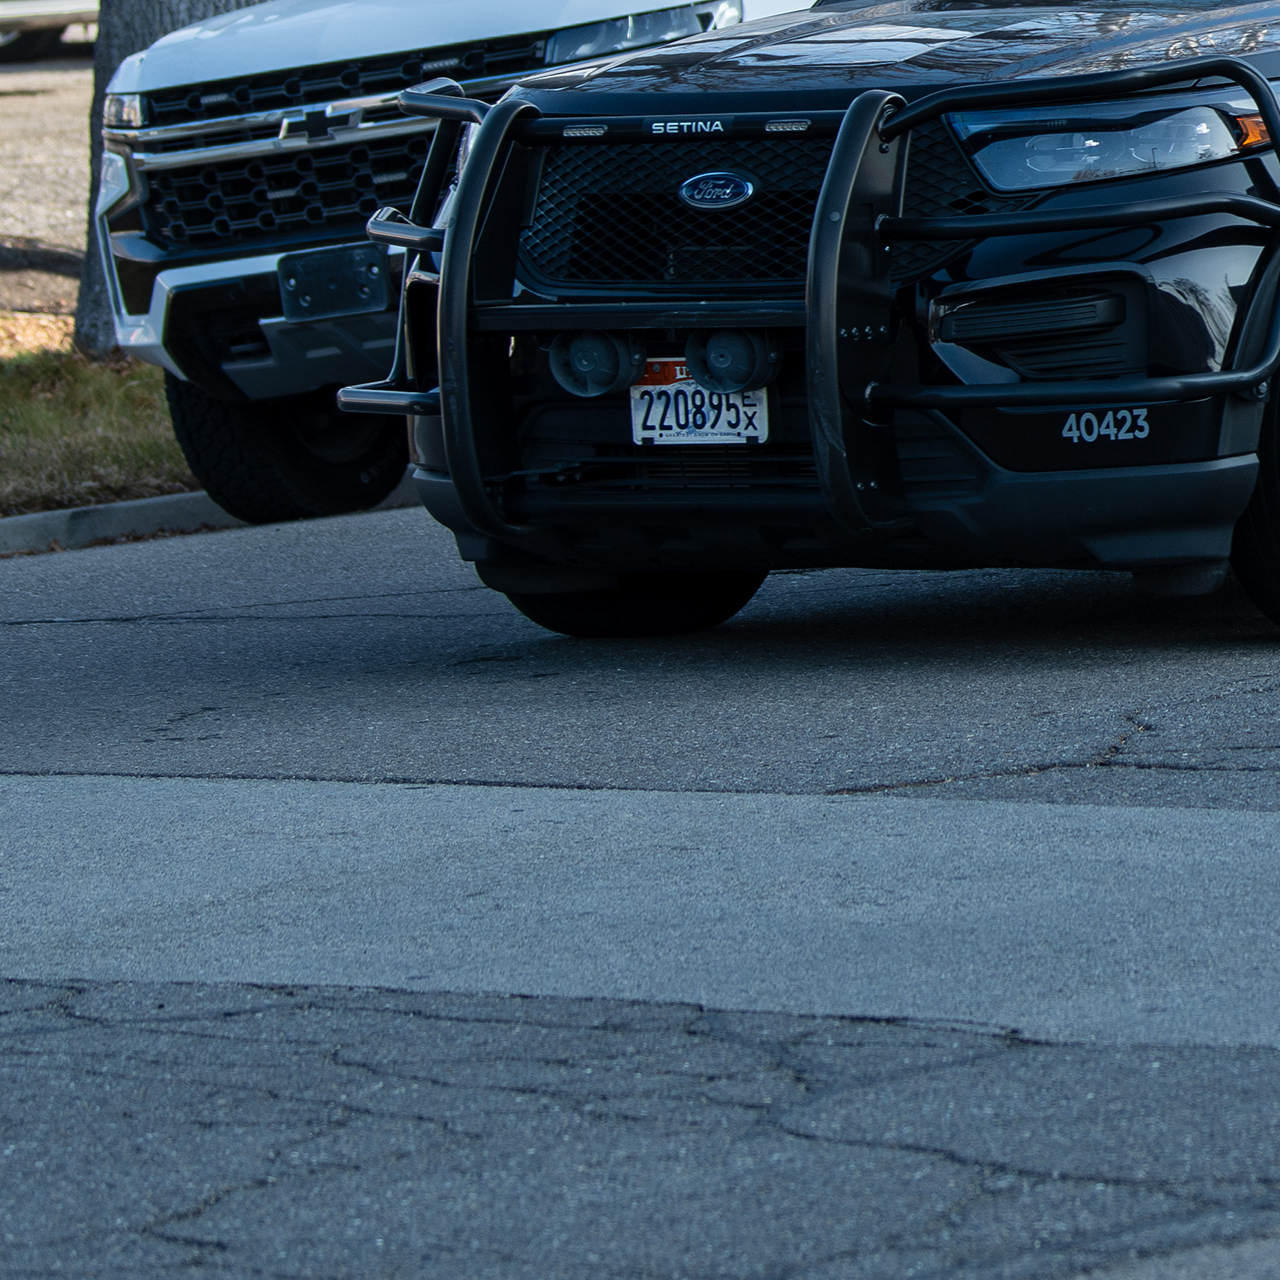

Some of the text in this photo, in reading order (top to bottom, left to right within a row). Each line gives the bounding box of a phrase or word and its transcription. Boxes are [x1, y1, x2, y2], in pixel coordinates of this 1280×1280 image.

[652, 121, 724, 134] SETINA
[694, 180, 734, 200] Ford
[640, 389, 741, 432] 220895
[1062, 408, 1150, 444] 40423
